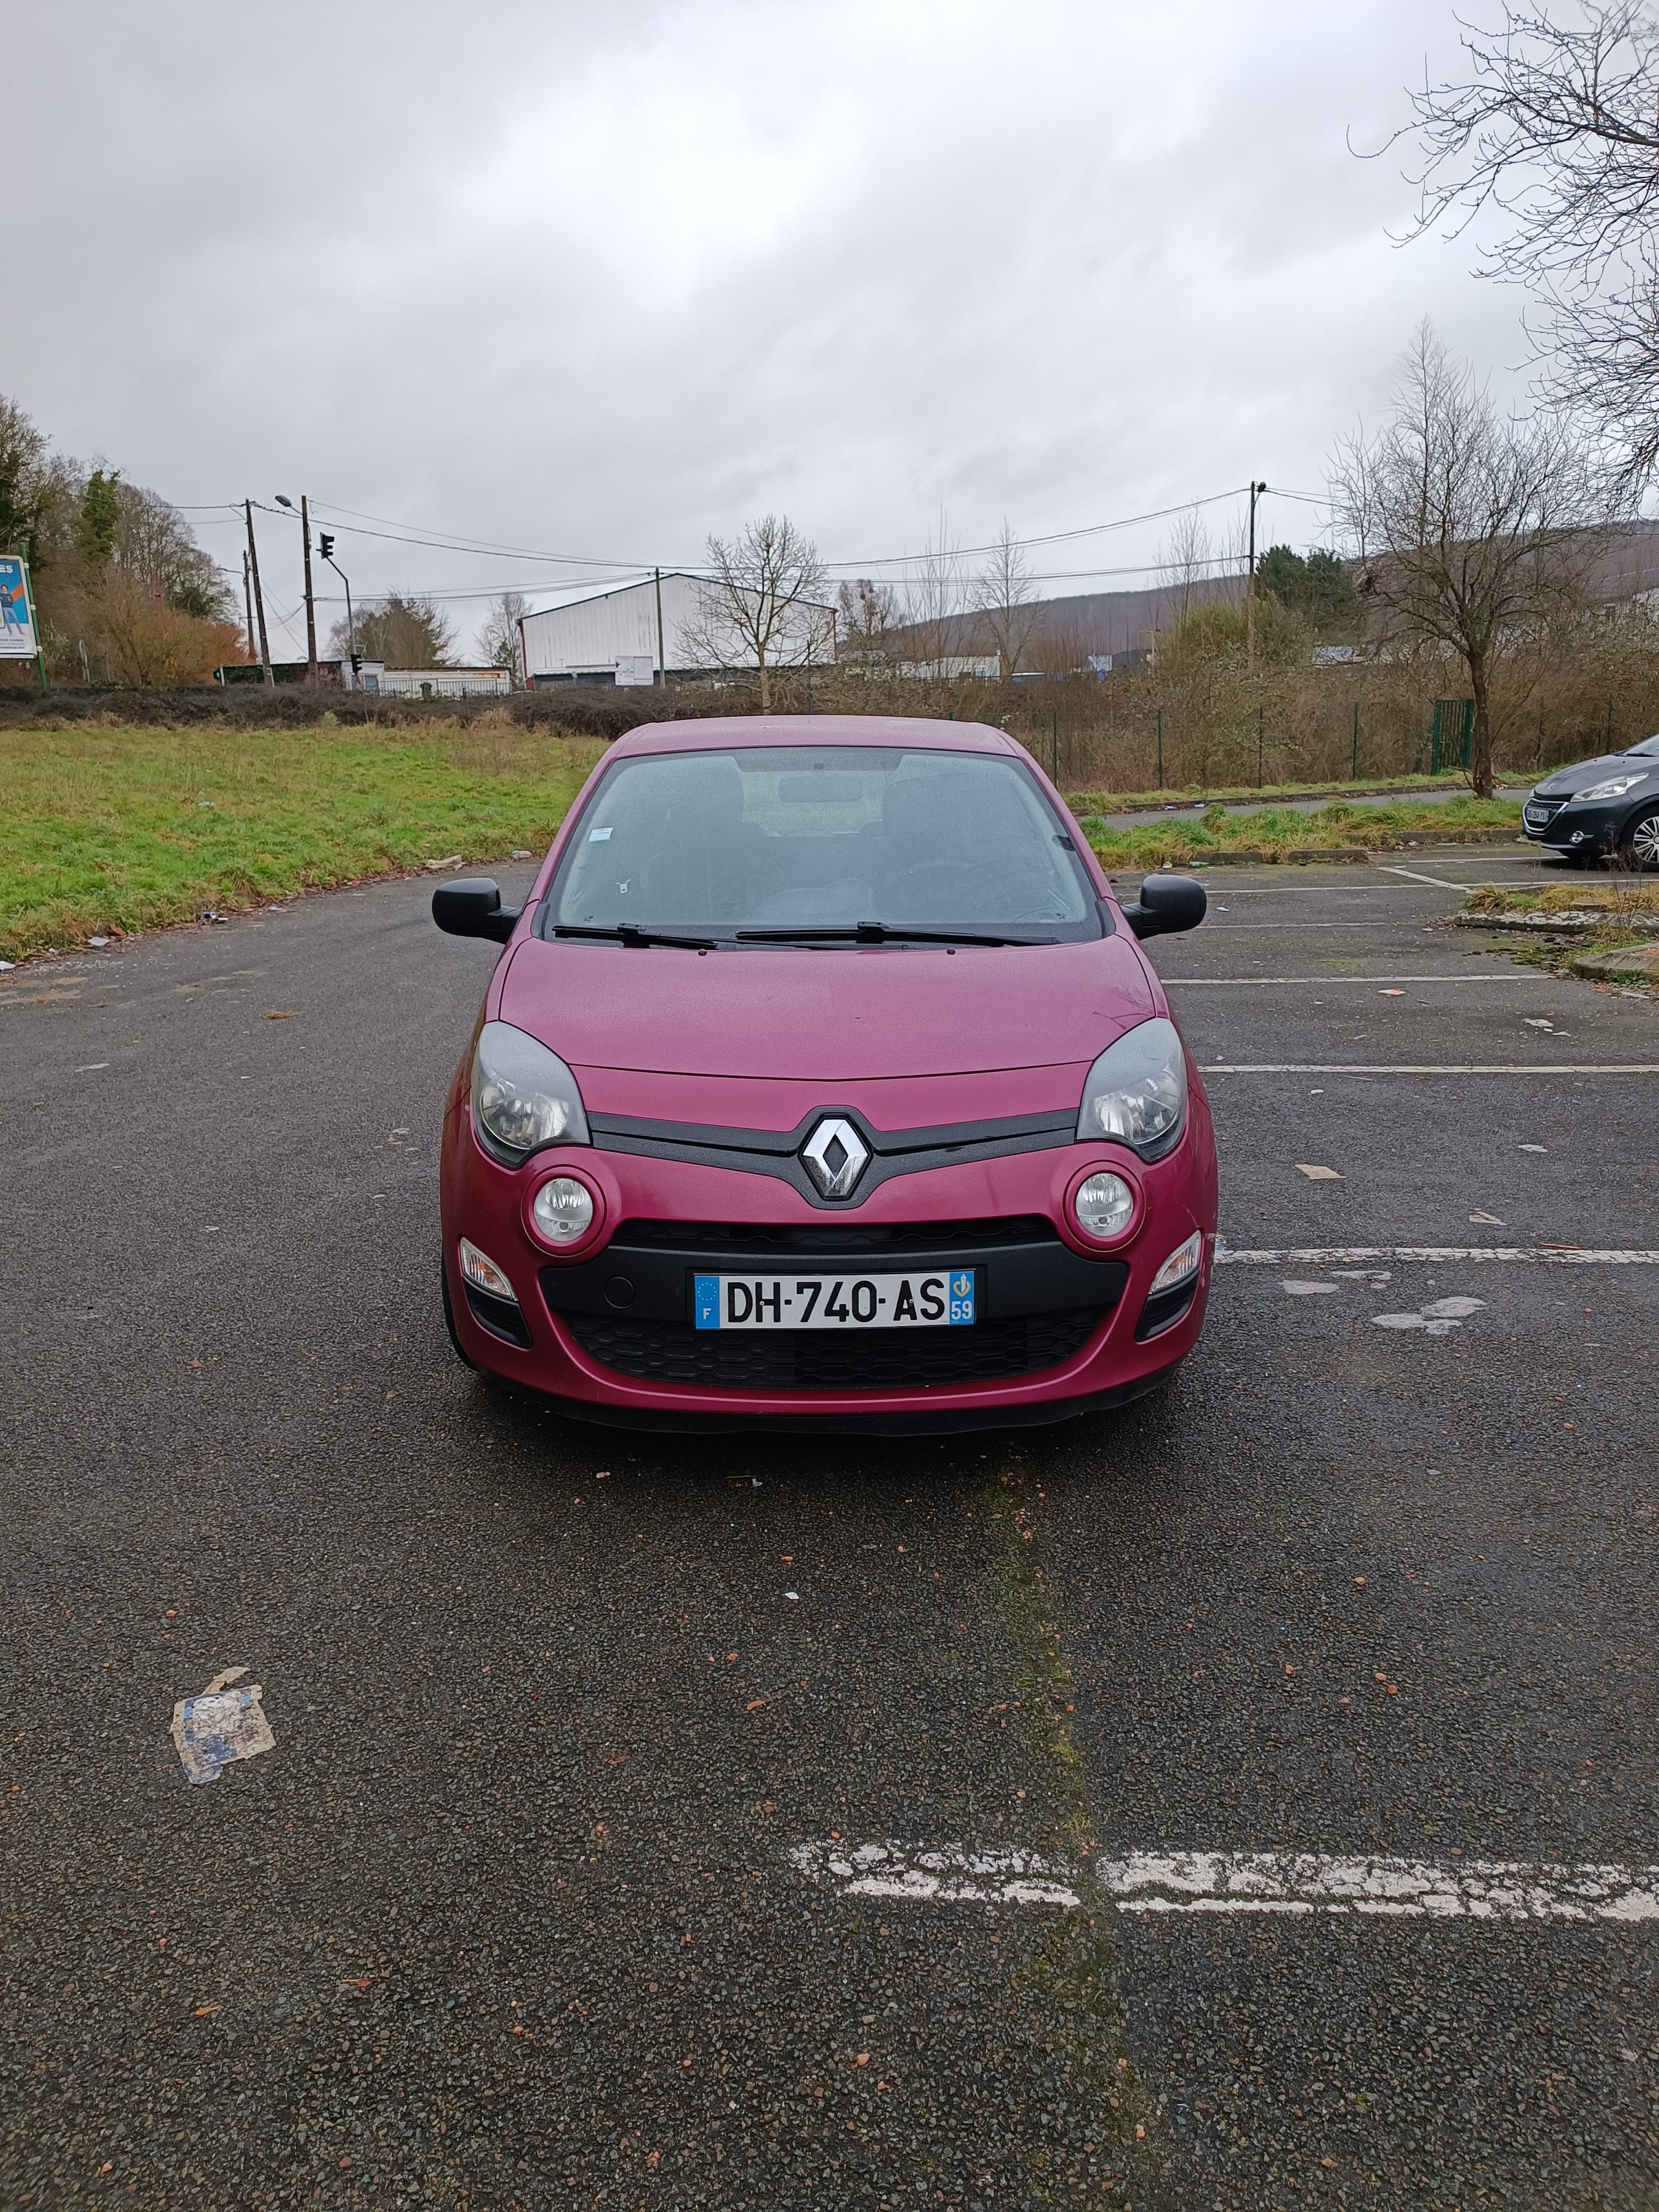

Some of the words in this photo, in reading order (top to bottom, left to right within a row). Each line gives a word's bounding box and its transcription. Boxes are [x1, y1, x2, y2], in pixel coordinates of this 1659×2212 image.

[727, 1278, 945, 1323] DH-740-AS
[951, 1300, 973, 1320] 59
[703, 1308, 712, 1319] F
